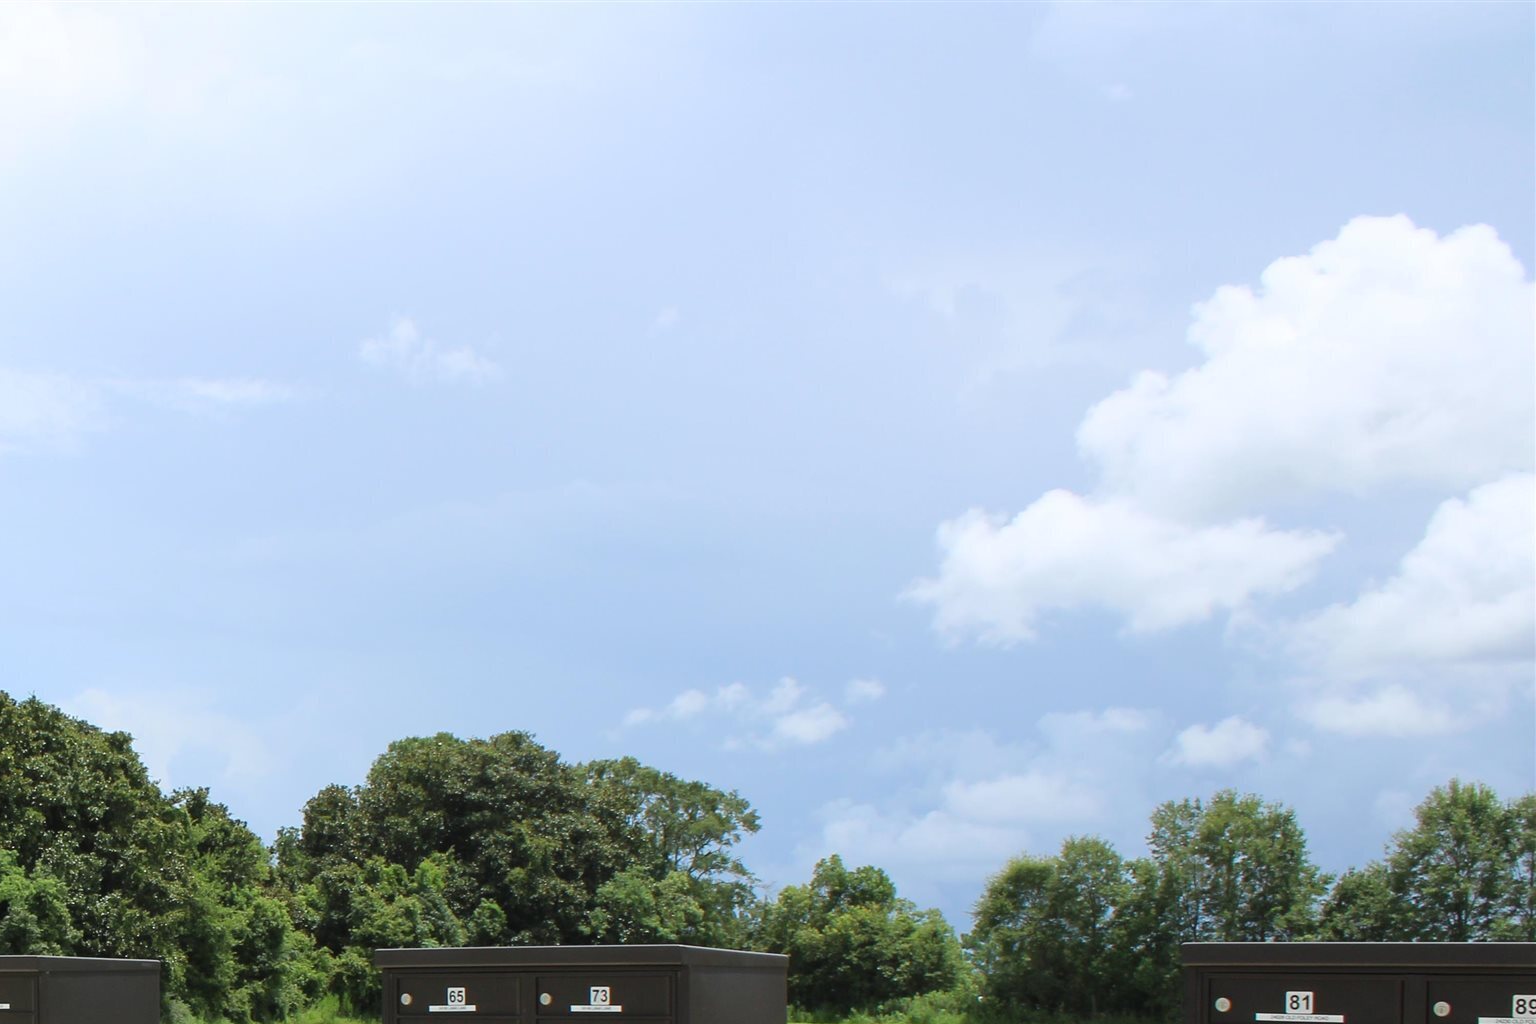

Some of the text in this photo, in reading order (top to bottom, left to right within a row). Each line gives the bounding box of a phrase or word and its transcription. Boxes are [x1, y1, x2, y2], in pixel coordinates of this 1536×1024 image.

[449, 990, 464, 1003] 65
[592, 989, 608, 1002] 73
[1290, 994, 1310, 1010] 81
[1515, 998, 1536, 1015] 89
